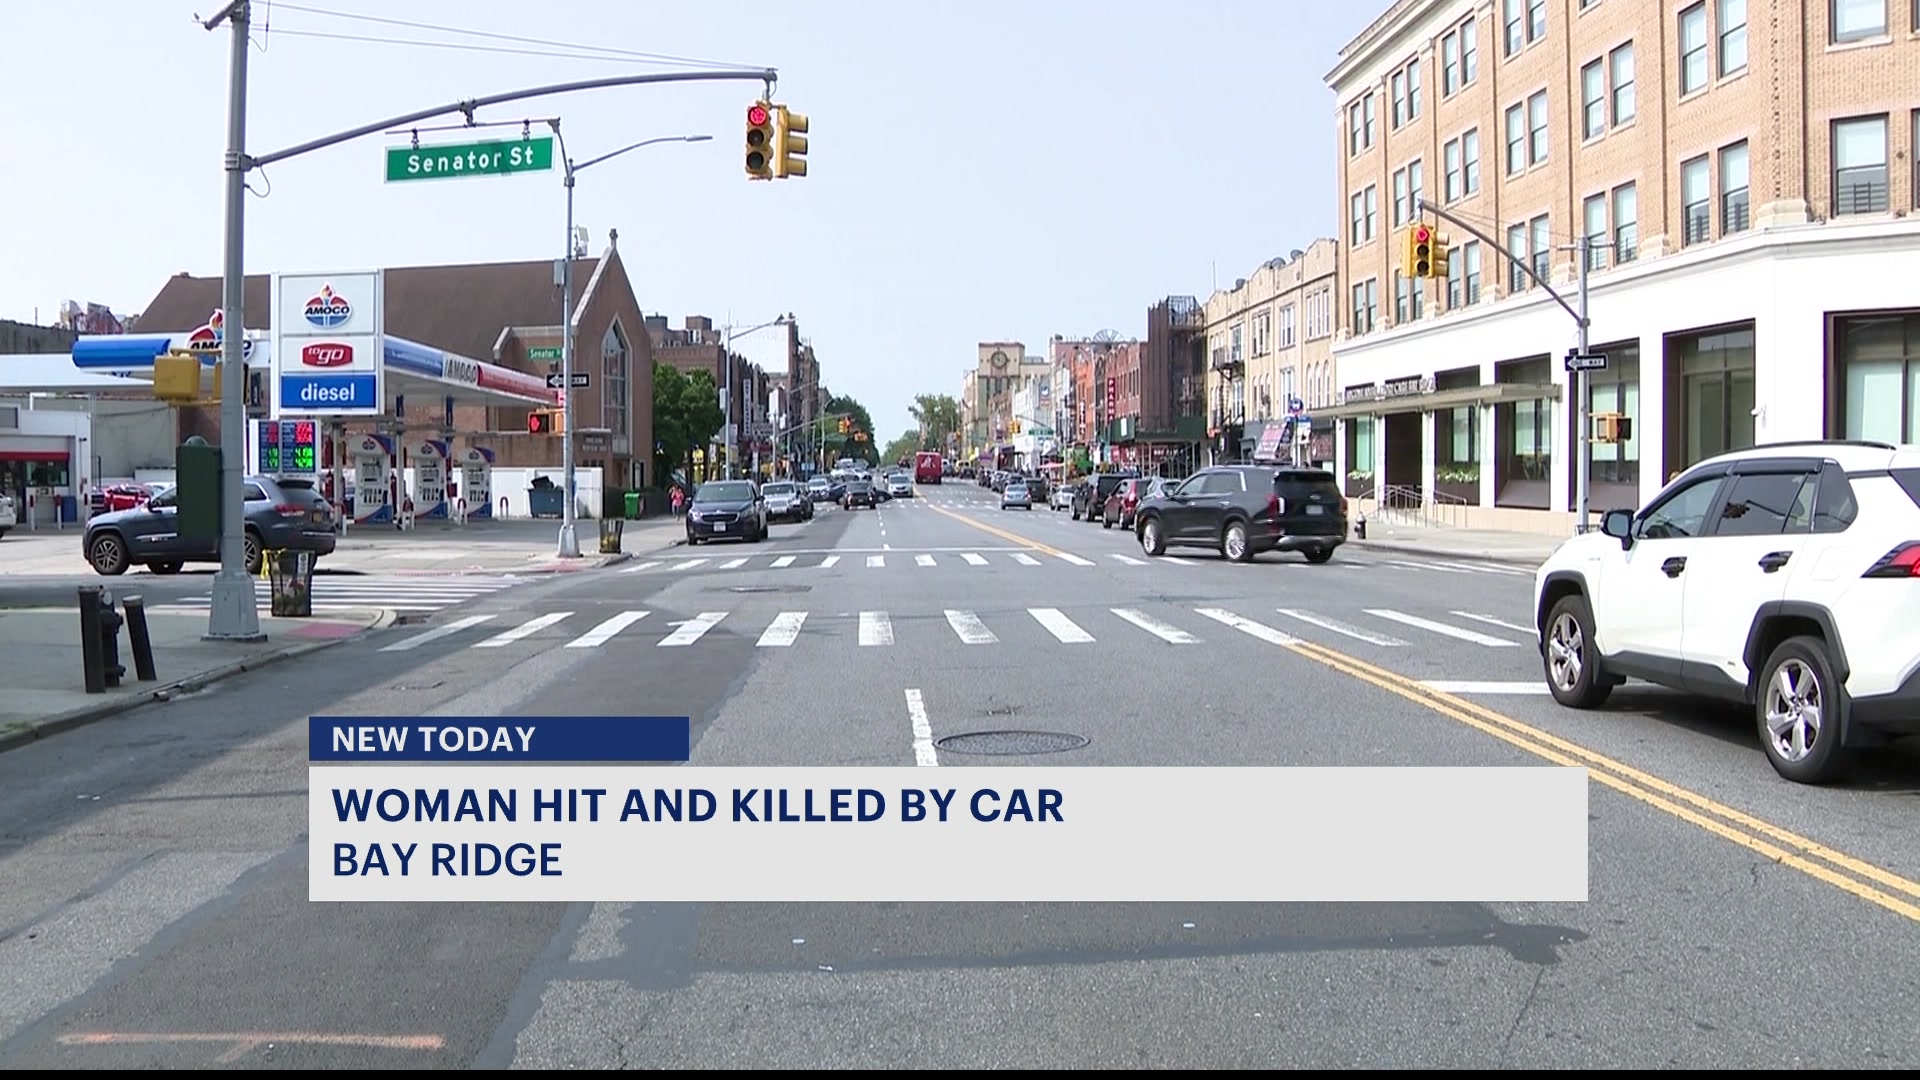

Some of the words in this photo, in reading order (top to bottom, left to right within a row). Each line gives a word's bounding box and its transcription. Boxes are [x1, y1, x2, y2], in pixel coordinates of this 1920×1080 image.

[407, 151, 502, 173] Senator
[510, 146, 534, 166] St
[304, 305, 350, 316] AMOCO
[529, 349, 555, 359] Senator
[447, 358, 477, 383] AMOCO
[300, 382, 355, 401] diesel
